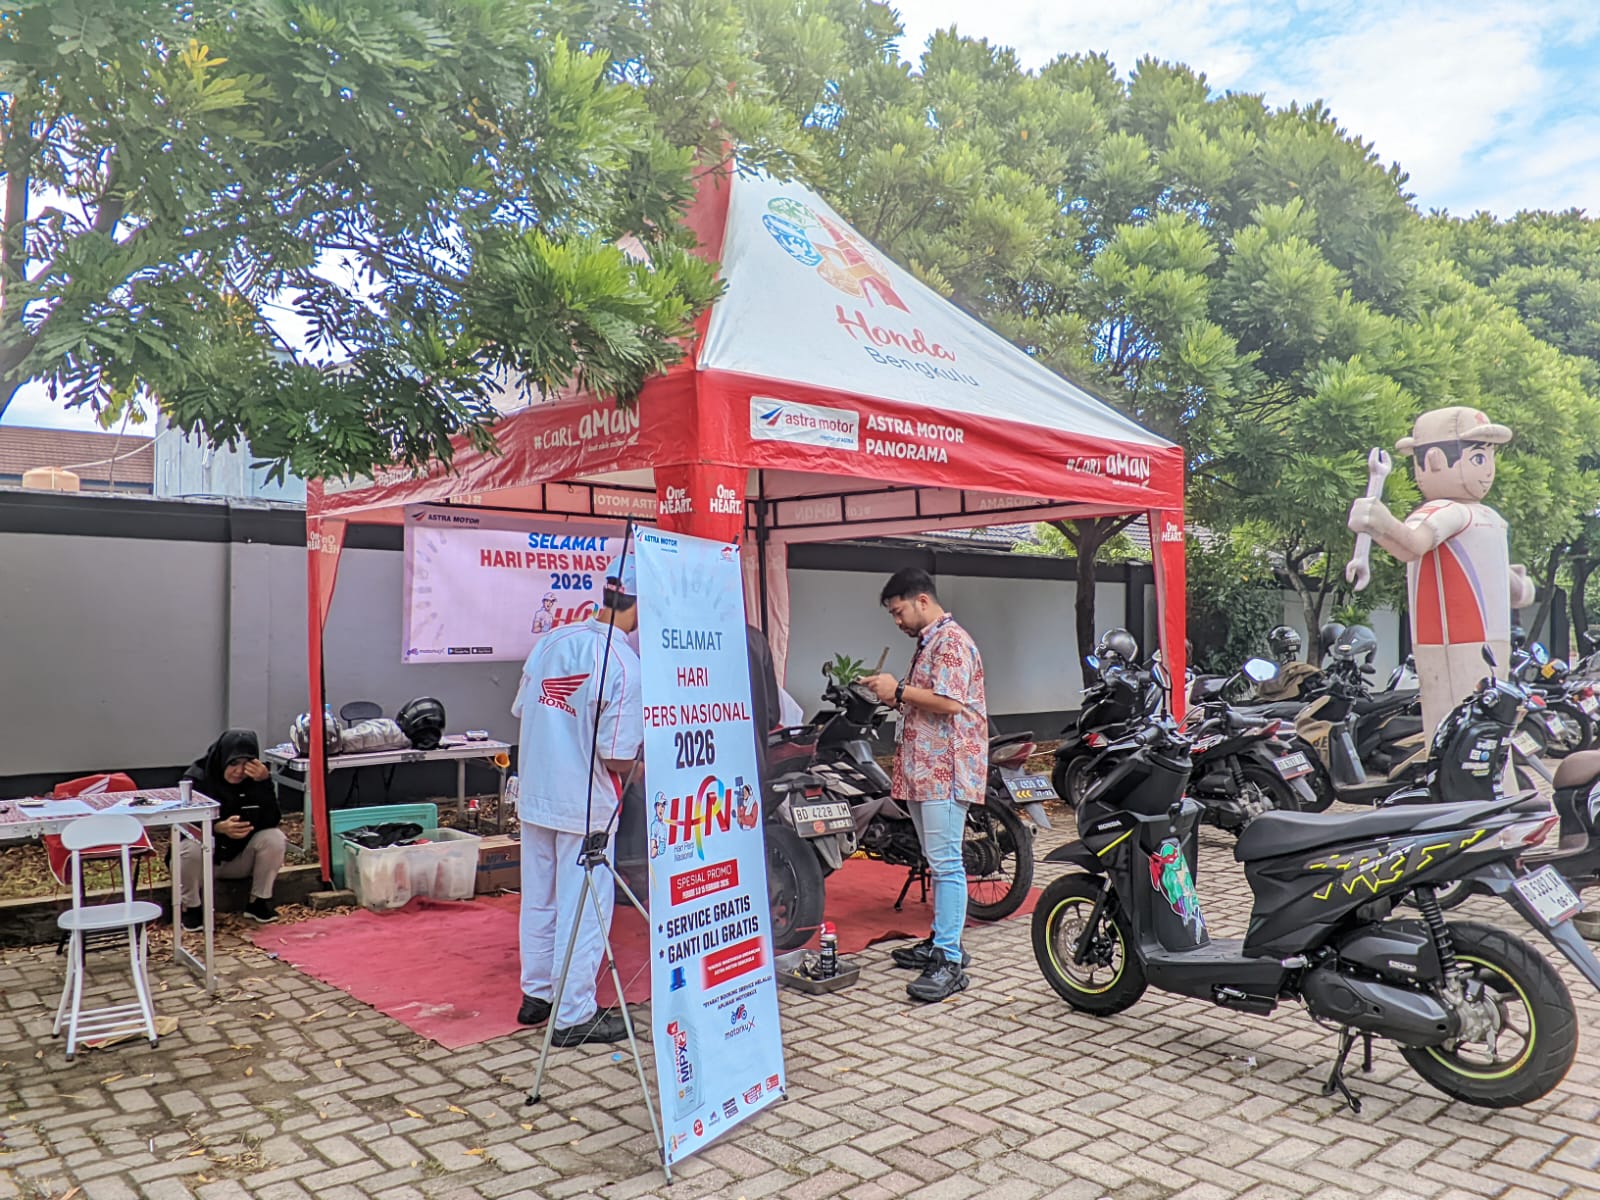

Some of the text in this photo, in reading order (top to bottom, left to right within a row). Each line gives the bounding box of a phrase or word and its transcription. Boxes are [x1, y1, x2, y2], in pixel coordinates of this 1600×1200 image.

[836, 304, 956, 362] Honda
[864, 345, 980, 387] Bengkulu
[785, 413, 855, 434] astra motor
[866, 414, 965, 443] ASTRA MOTOR
[866, 438, 948, 463] PANORAMA
[666, 485, 686, 500] One
[716, 484, 736, 500] One
[709, 497, 743, 515] HEART.
[427, 513, 481, 525] ASTRA MOTOR
[528, 532, 609, 551] SELAMAT
[480, 549, 522, 568] HARI
[525, 551, 569, 570] PERS
[550, 572, 593, 590] 2026
[661, 628, 723, 651] SELAMAT
[676, 666, 709, 687] HARI
[538, 695, 577, 718] HONDA
[643, 702, 751, 728] PERS NASIONAL
[674, 728, 716, 770] 2026
[796, 808, 809, 821] BD
[676, 873, 706, 890] SPESIAL
[707, 864, 732, 881] PROMO
[666, 895, 751, 939] SERVICE GRATIS
[668, 935, 701, 964] GANTI
[703, 928, 720, 951] OLI
[721, 915, 759, 943] GRATIS
